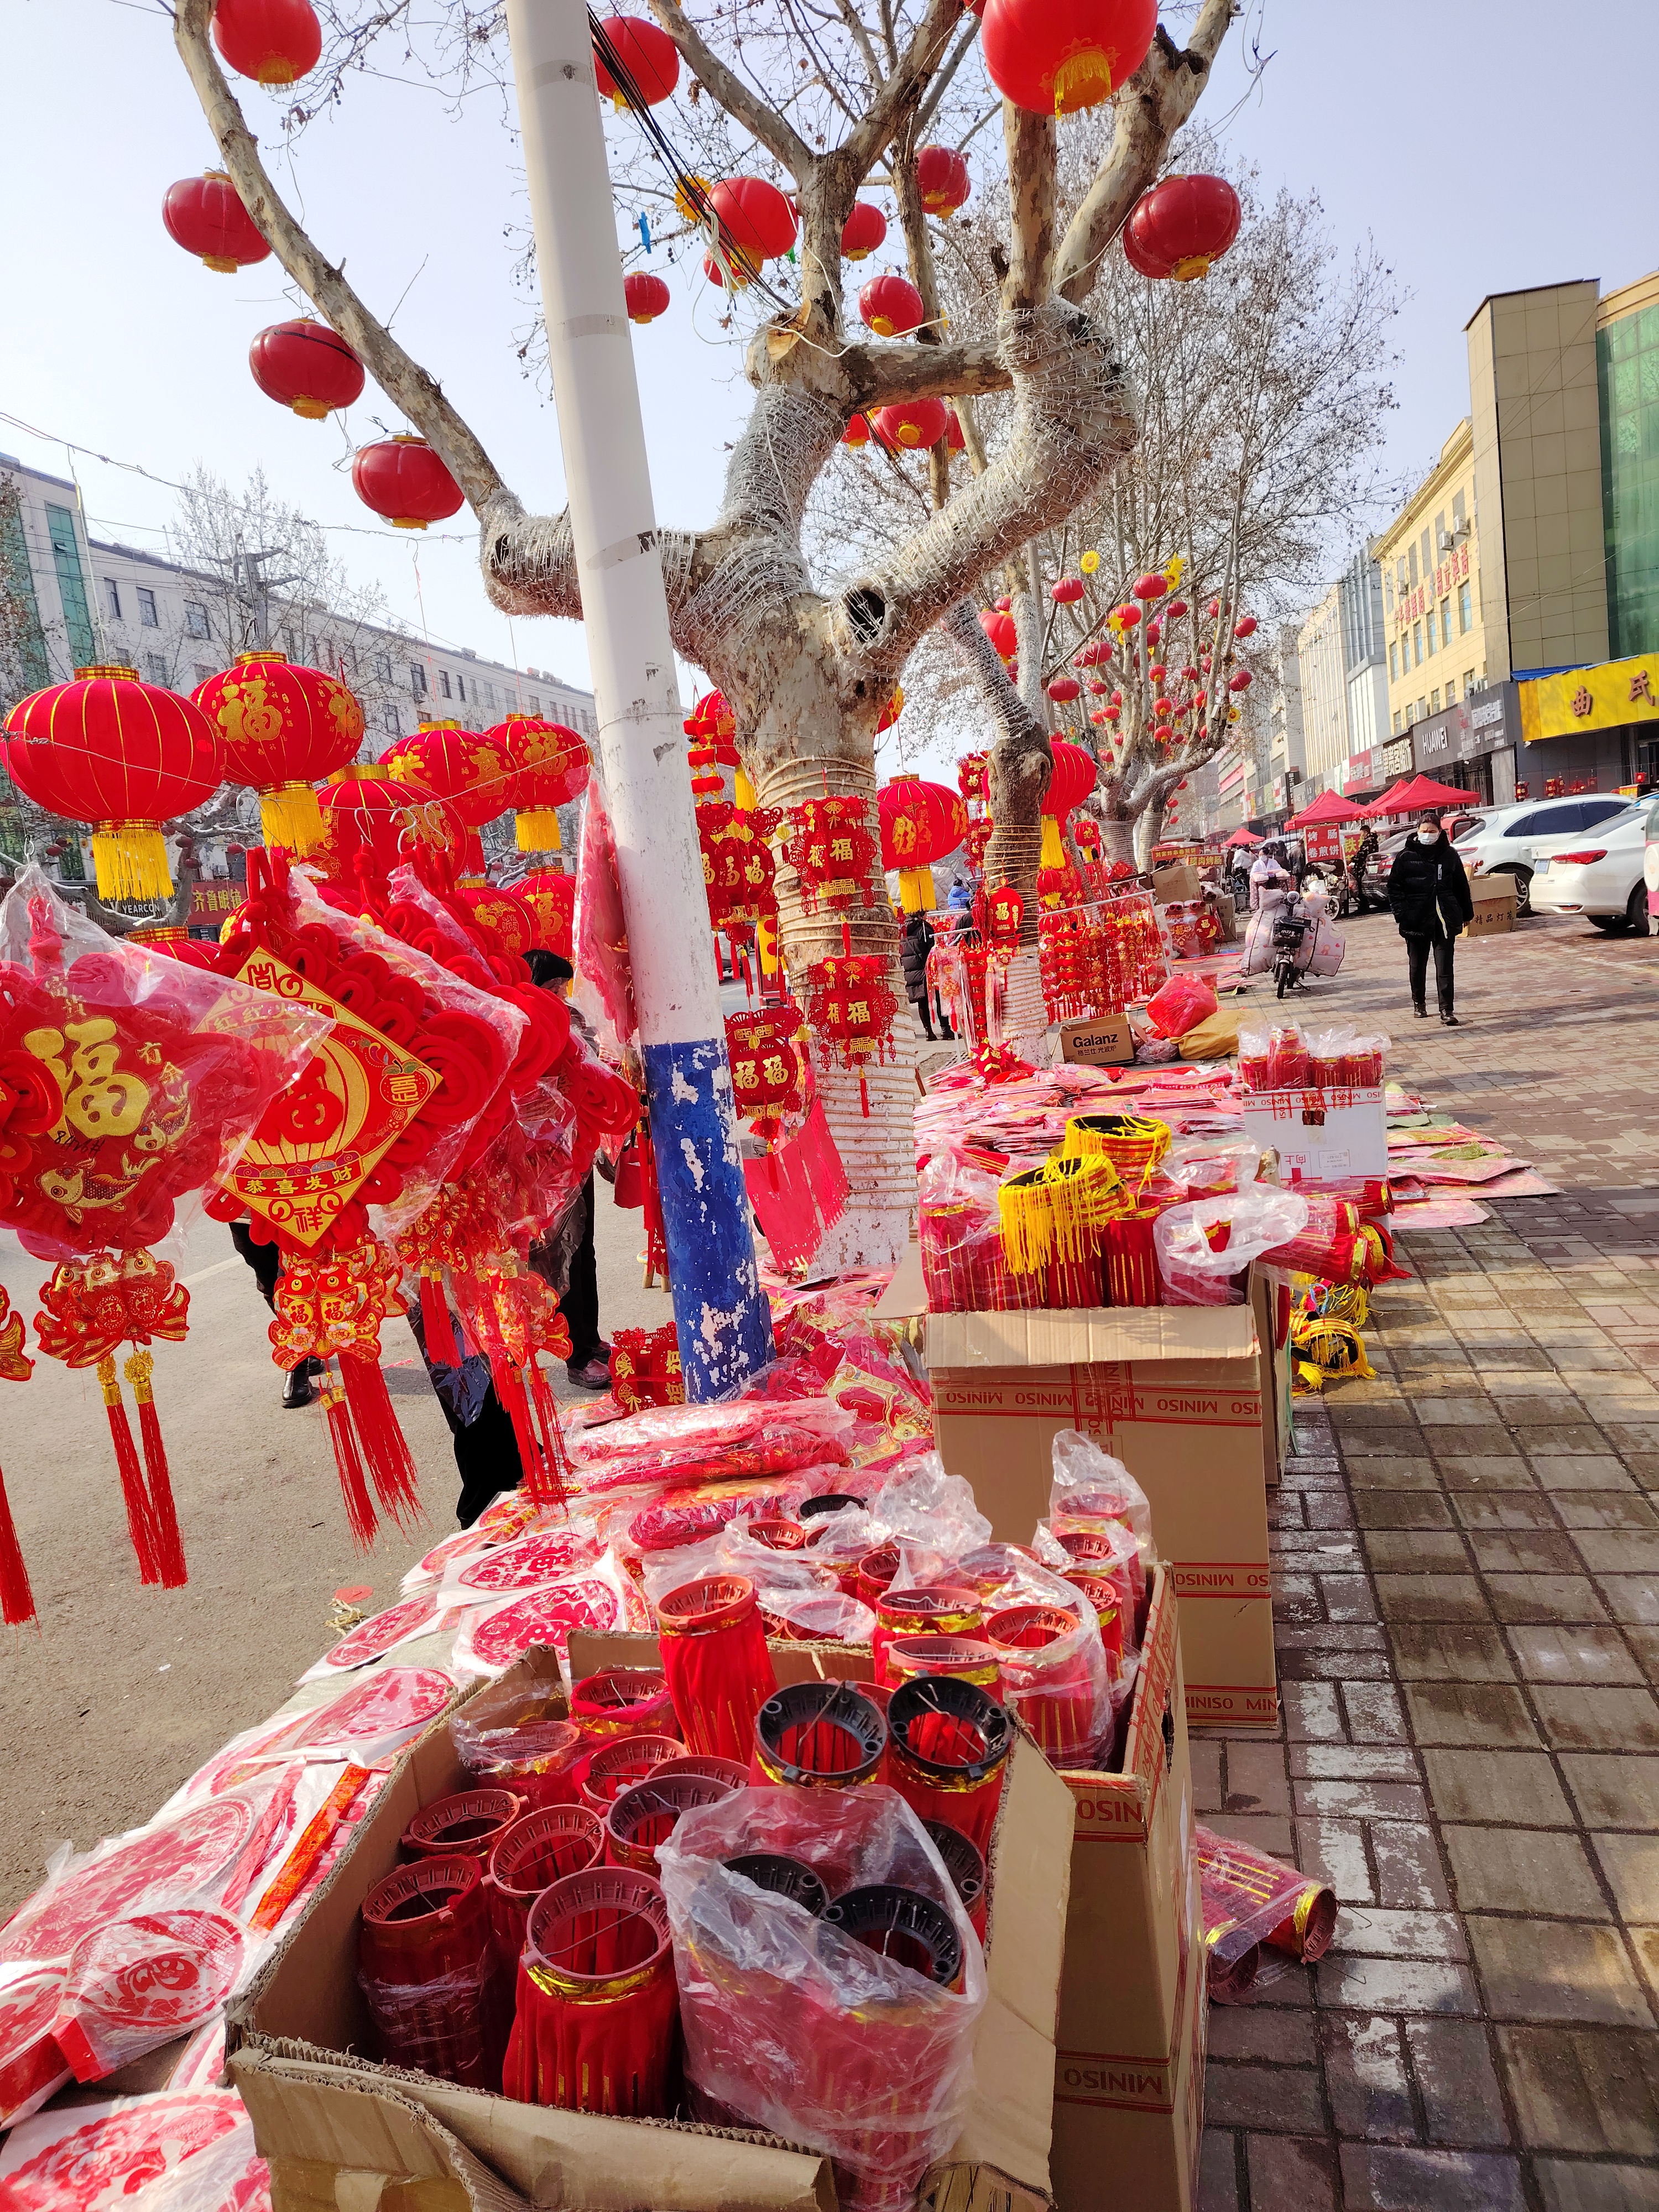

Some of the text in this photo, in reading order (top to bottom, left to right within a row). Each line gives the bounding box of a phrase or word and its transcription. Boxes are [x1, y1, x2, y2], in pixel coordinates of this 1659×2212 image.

[217, 679, 283, 744] 福
[1422, 726, 1448, 755] HUAWEI
[523, 732, 567, 775] 福
[466, 747, 512, 797] 喜
[967, 775, 978, 787] 福
[830, 838, 853, 862] 福
[1308, 845, 1339, 858] 卷煎饼
[745, 855, 765, 884] 福
[122, 904, 160, 914] YEARCON
[192, 889, 242, 912] 齐鲁眼镜
[995, 902, 1010, 920] 福
[847, 1001, 870, 1024] 福
[1073, 1034, 1119, 1048] Galanz
[1077, 1048, 1097, 1056] 格兰仕
[135, 1041, 185, 1084] 有余
[763, 1055, 788, 1086] 福
[21, 1015, 151, 1145] 福
[733, 1060, 759, 1089] 福
[1284, 1154, 1306, 1165] 向上
[244, 1166, 353, 1195] 恭喜发财
[293, 1207, 324, 1234] 祥
[290, 1304, 309, 1324] 福
[325, 1301, 345, 1320] 福
[946, 1392, 1003, 1405] MINISO
[1015, 1392, 1073, 1406] MINISO
[1157, 1399, 1217, 1413] MINISO
[1176, 1572, 1234, 1587] MINISO
[1065, 2070, 1162, 2095] MINISO
